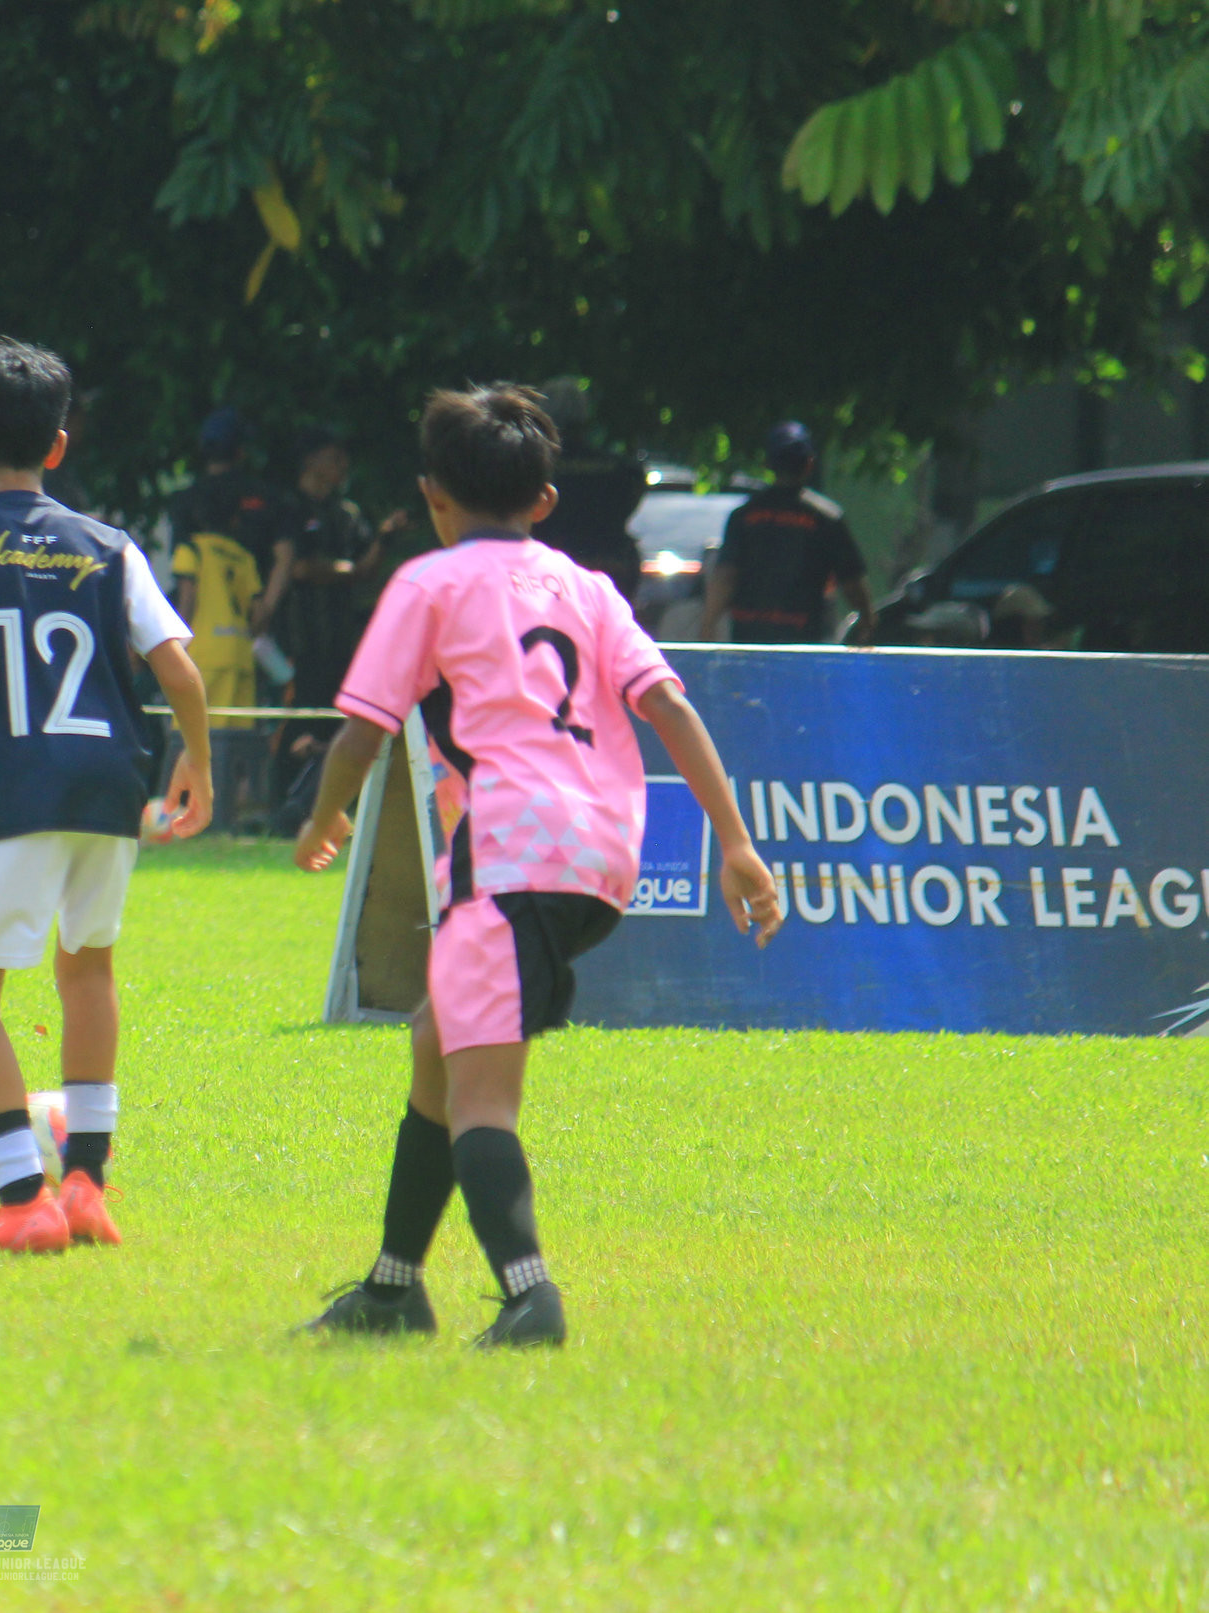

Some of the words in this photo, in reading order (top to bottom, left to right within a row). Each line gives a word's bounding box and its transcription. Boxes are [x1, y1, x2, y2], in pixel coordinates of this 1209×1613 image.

[21, 534, 57, 545] FFF
[520, 625, 595, 750] 2
[750, 780, 1120, 847] INDONESIA
[1029, 866, 1209, 929] LEAG
